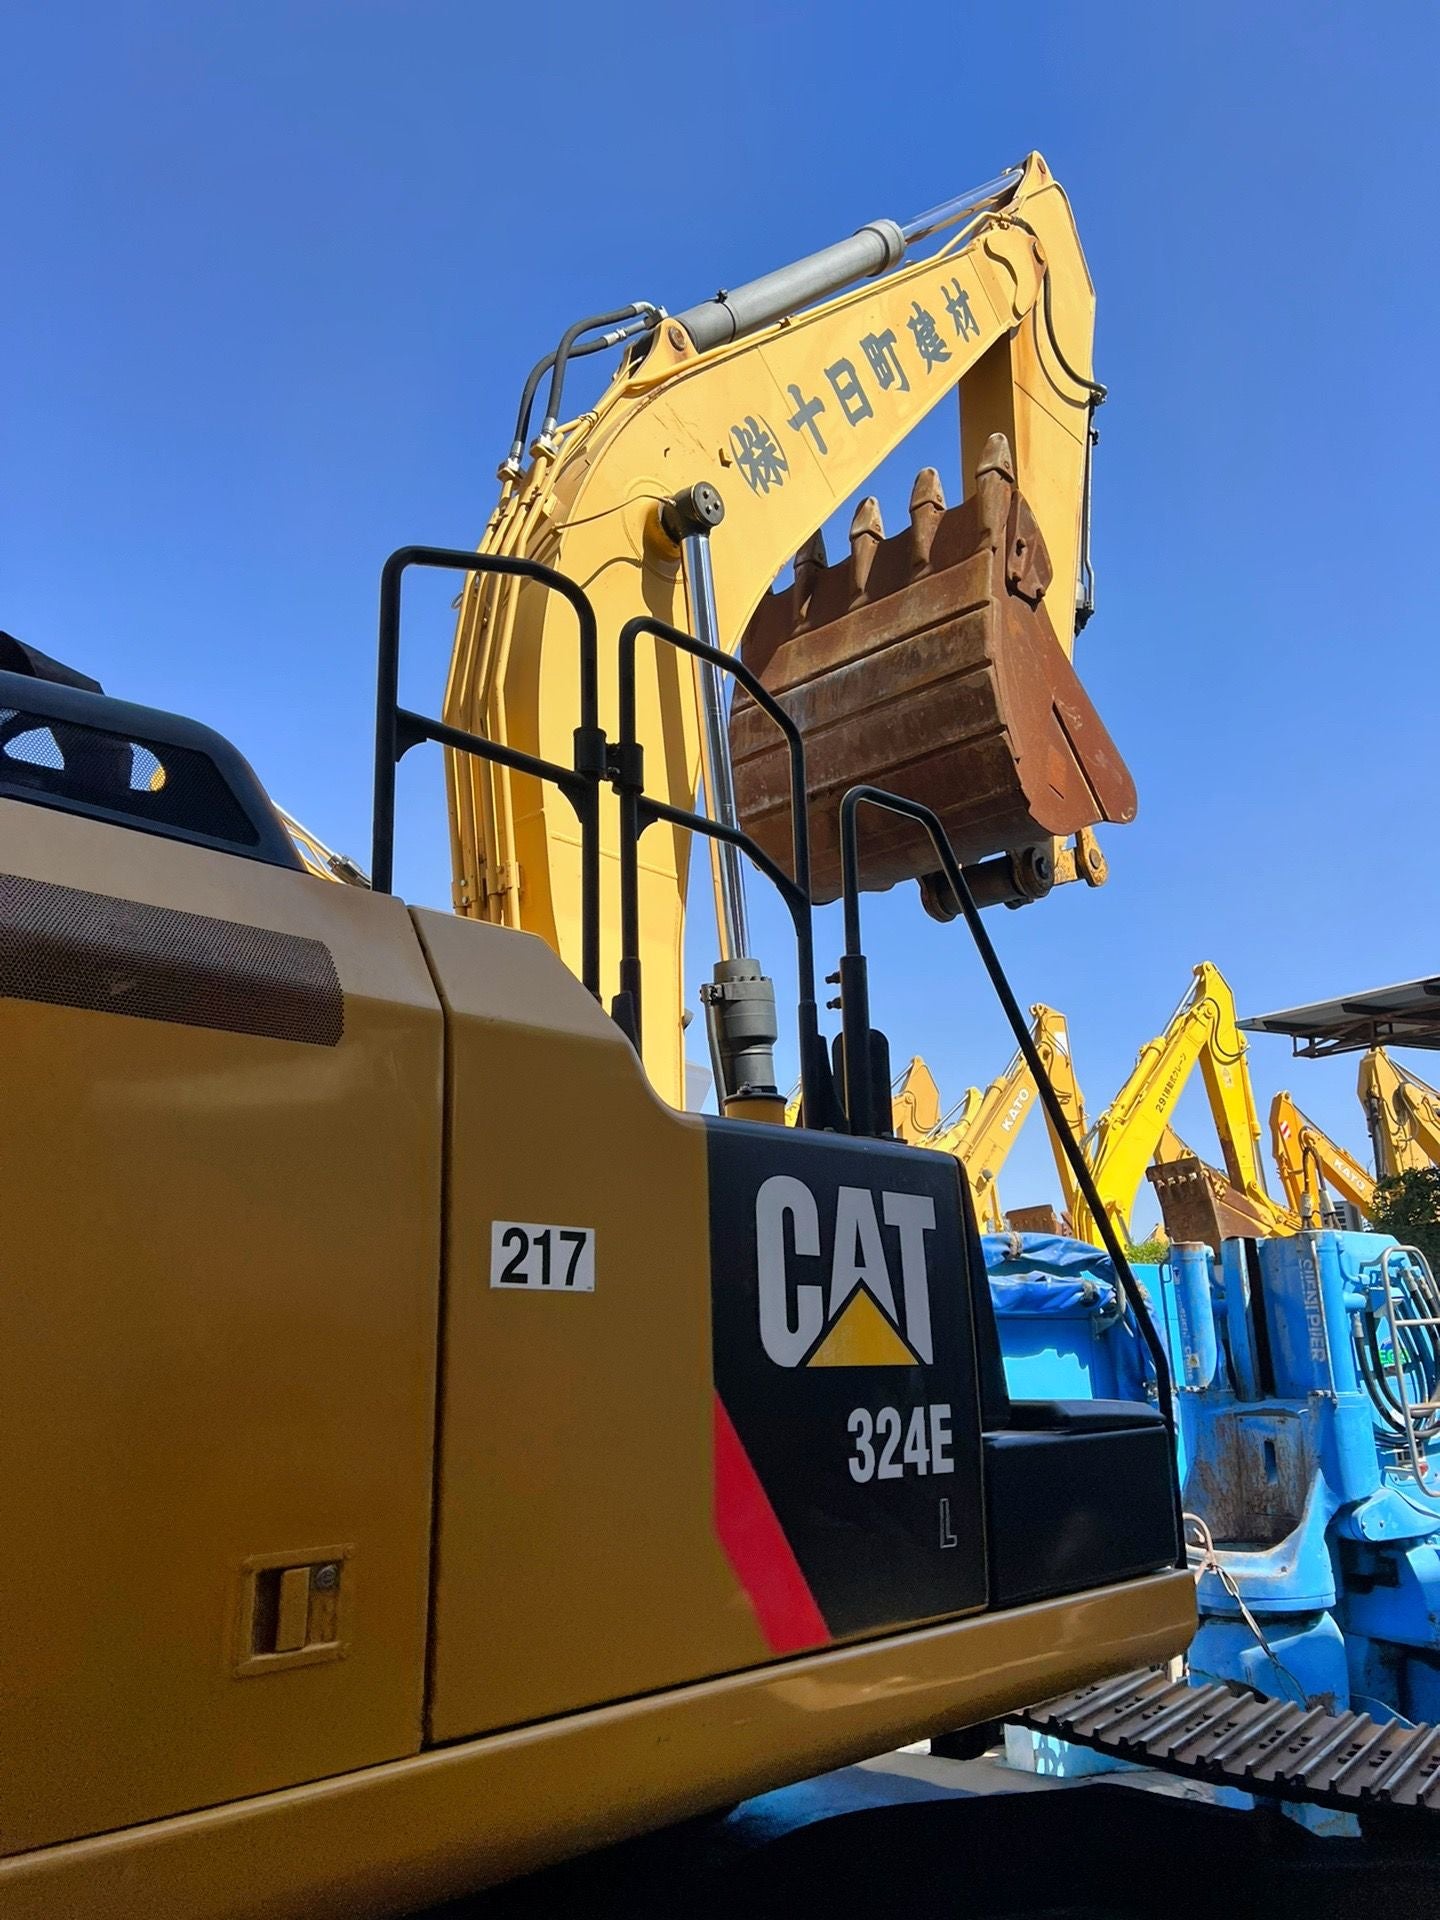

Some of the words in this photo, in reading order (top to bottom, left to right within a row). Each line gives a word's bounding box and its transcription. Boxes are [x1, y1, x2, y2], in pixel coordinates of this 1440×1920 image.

[1001, 1088, 1030, 1132] KATO
[1334, 1159, 1365, 1190] KATO
[500, 1226, 587, 1287] 217
[756, 1175, 936, 1367] CAT
[847, 1403, 955, 1484] 324E
[940, 1498, 957, 1549] L
